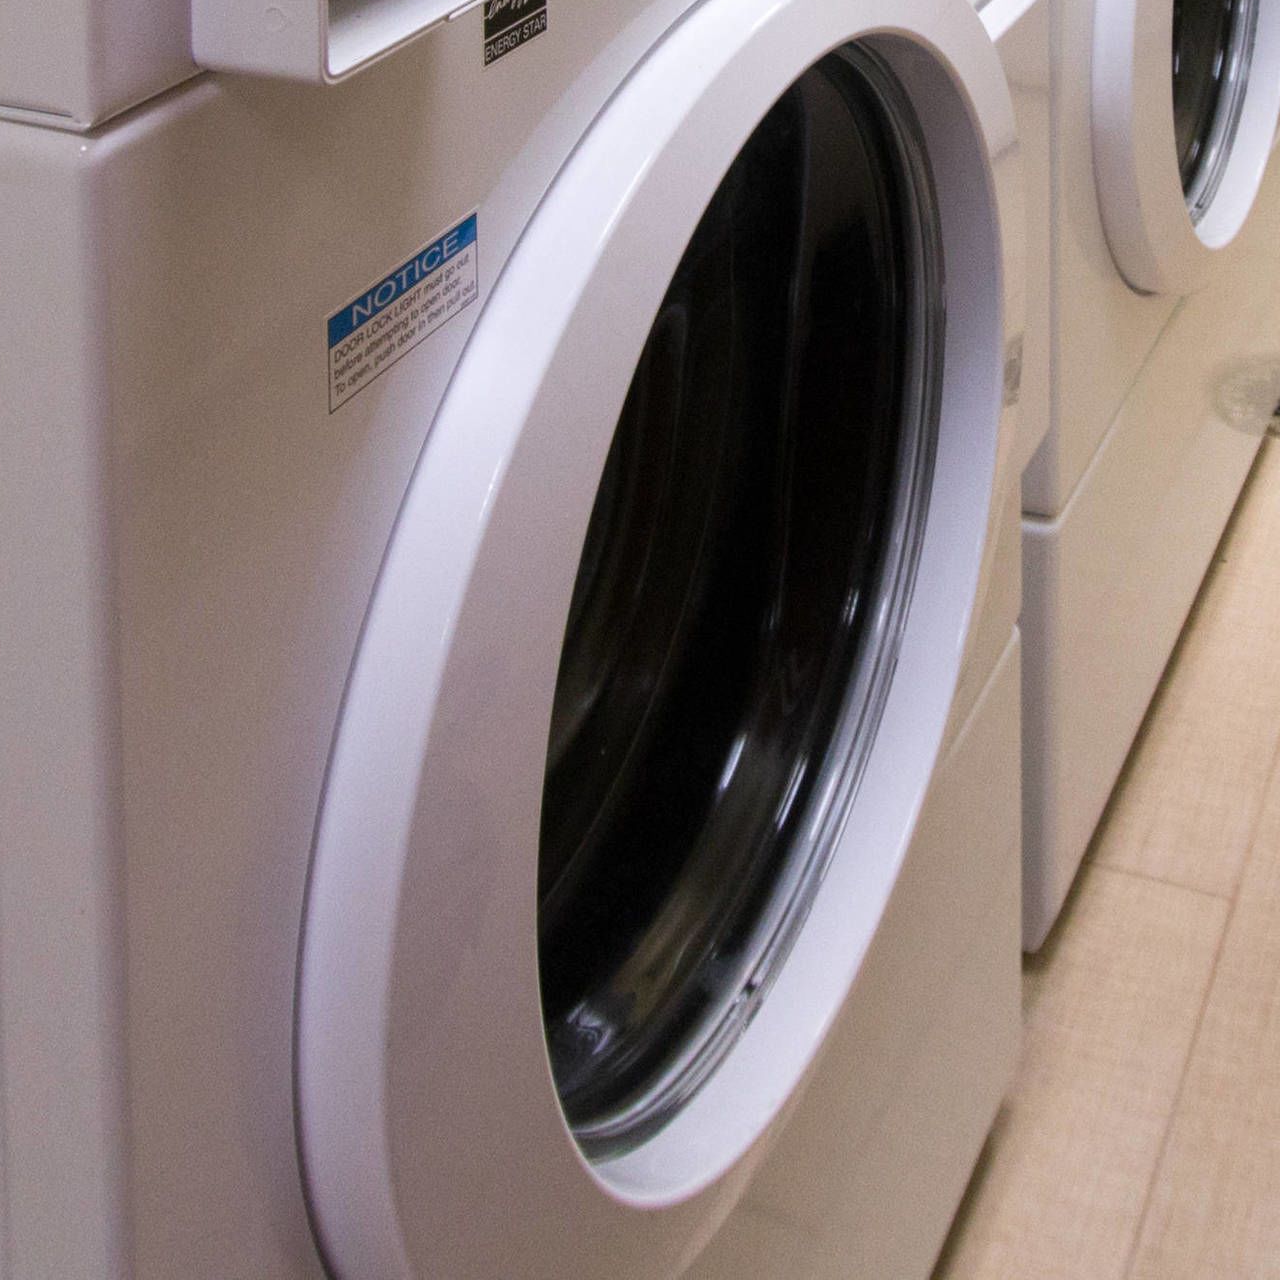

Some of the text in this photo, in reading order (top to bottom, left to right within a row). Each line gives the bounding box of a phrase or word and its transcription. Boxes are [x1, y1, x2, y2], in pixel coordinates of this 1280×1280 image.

[485, 14, 547, 62] ENERGY STAR
[352, 231, 460, 326] NOTICE
[334, 331, 364, 363] DOOR
[366, 310, 393, 339] LOCK
[394, 288, 422, 317] LIGHT
[423, 272, 443, 294] must
[334, 382, 346, 397] To
